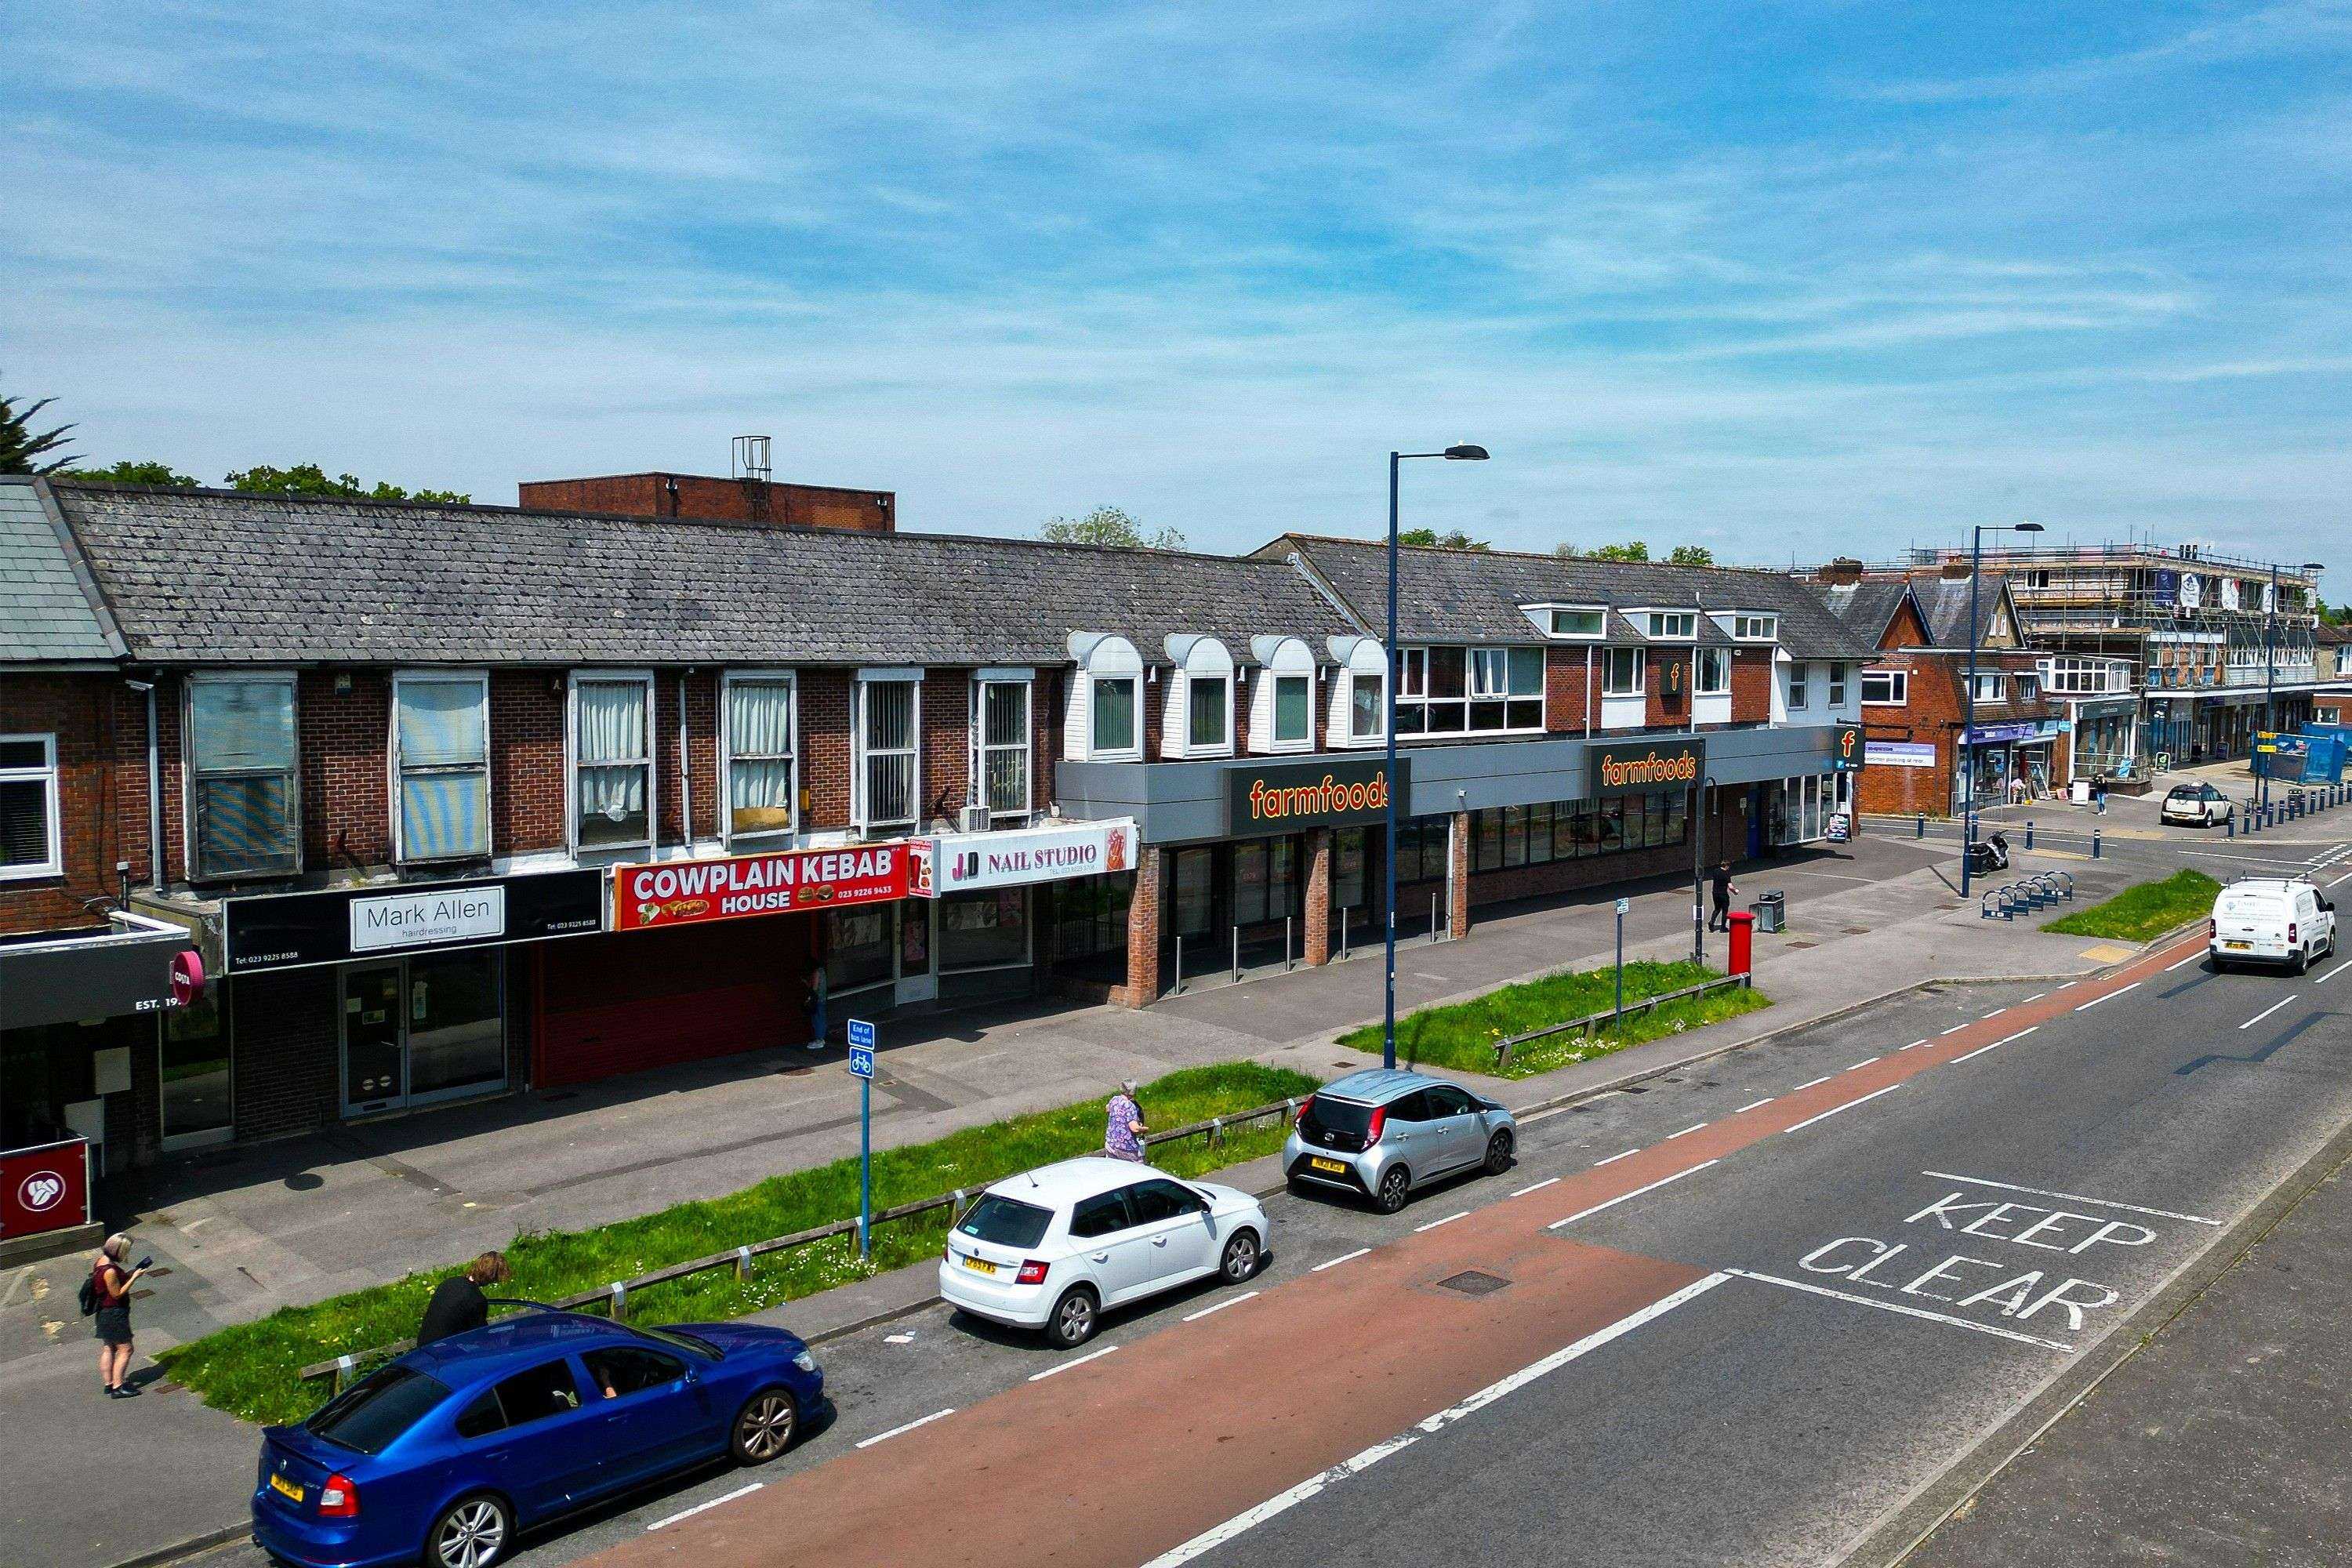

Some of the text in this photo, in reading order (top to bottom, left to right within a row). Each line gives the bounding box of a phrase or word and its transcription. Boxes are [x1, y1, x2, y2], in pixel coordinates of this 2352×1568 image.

[1671, 662, 1679, 691] f
[1841, 730, 1856, 758] f
[1602, 750, 1696, 786] farmfoods
[988, 851, 1031, 874] NAIL
[1034, 844, 1097, 869] STUDIO
[633, 850, 893, 900] COWPLAIN KEBAB
[721, 891, 790, 913] HOUSE
[838, 890, 852, 898] 023
[854, 887, 873, 897] 9226
[368, 900, 490, 928] Mark Allen
[401, 925, 457, 938] hairdressing
[136, 999, 161, 1011] EST.
[851, 1033, 860, 1042] bus
[852, 1024, 862, 1033] End
[1903, 1192, 2157, 1254] KEEP
[1798, 1236, 2119, 1330] CLEAR
